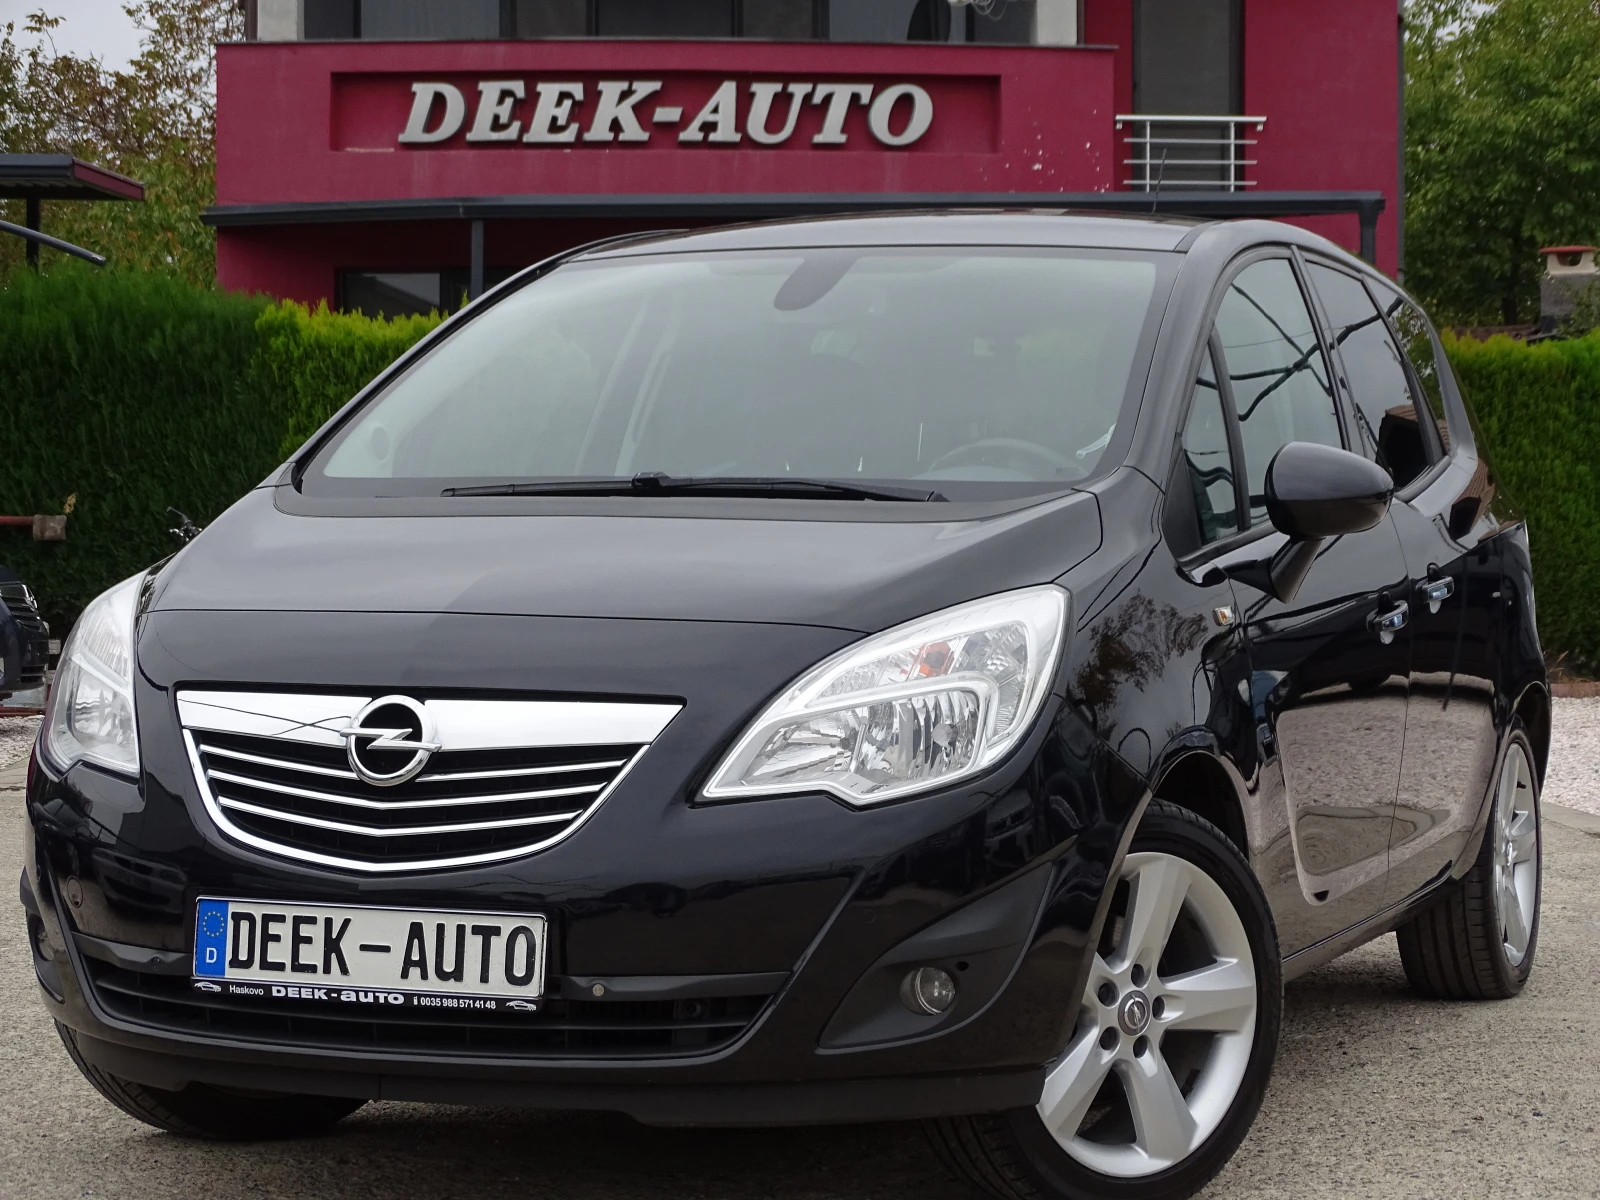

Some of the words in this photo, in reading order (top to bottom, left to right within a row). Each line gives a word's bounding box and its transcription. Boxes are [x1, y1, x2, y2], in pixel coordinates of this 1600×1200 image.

[398, 80, 934, 147] DEEK-AUTO
[205, 947, 218, 964] D
[229, 984, 264, 996] Haskovo
[420, 997, 441, 1007] 0035
